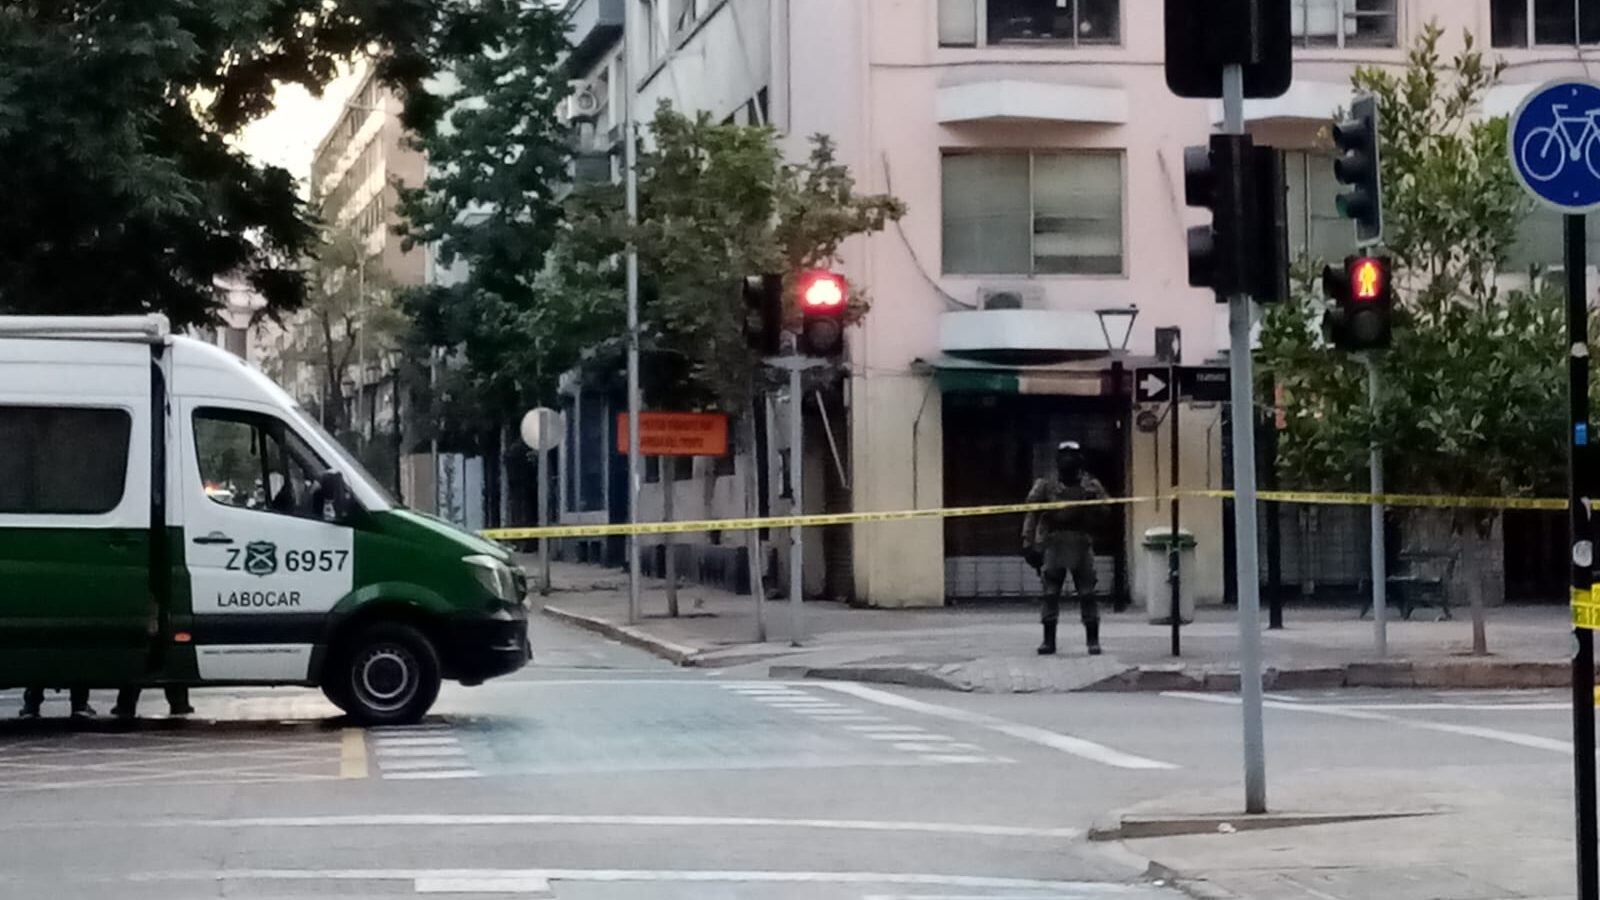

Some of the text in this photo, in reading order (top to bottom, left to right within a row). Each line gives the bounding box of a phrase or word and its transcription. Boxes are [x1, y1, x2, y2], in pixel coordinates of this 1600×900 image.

[225, 548, 349, 572] Z 6957
[217, 591, 301, 607] LABOCAR
